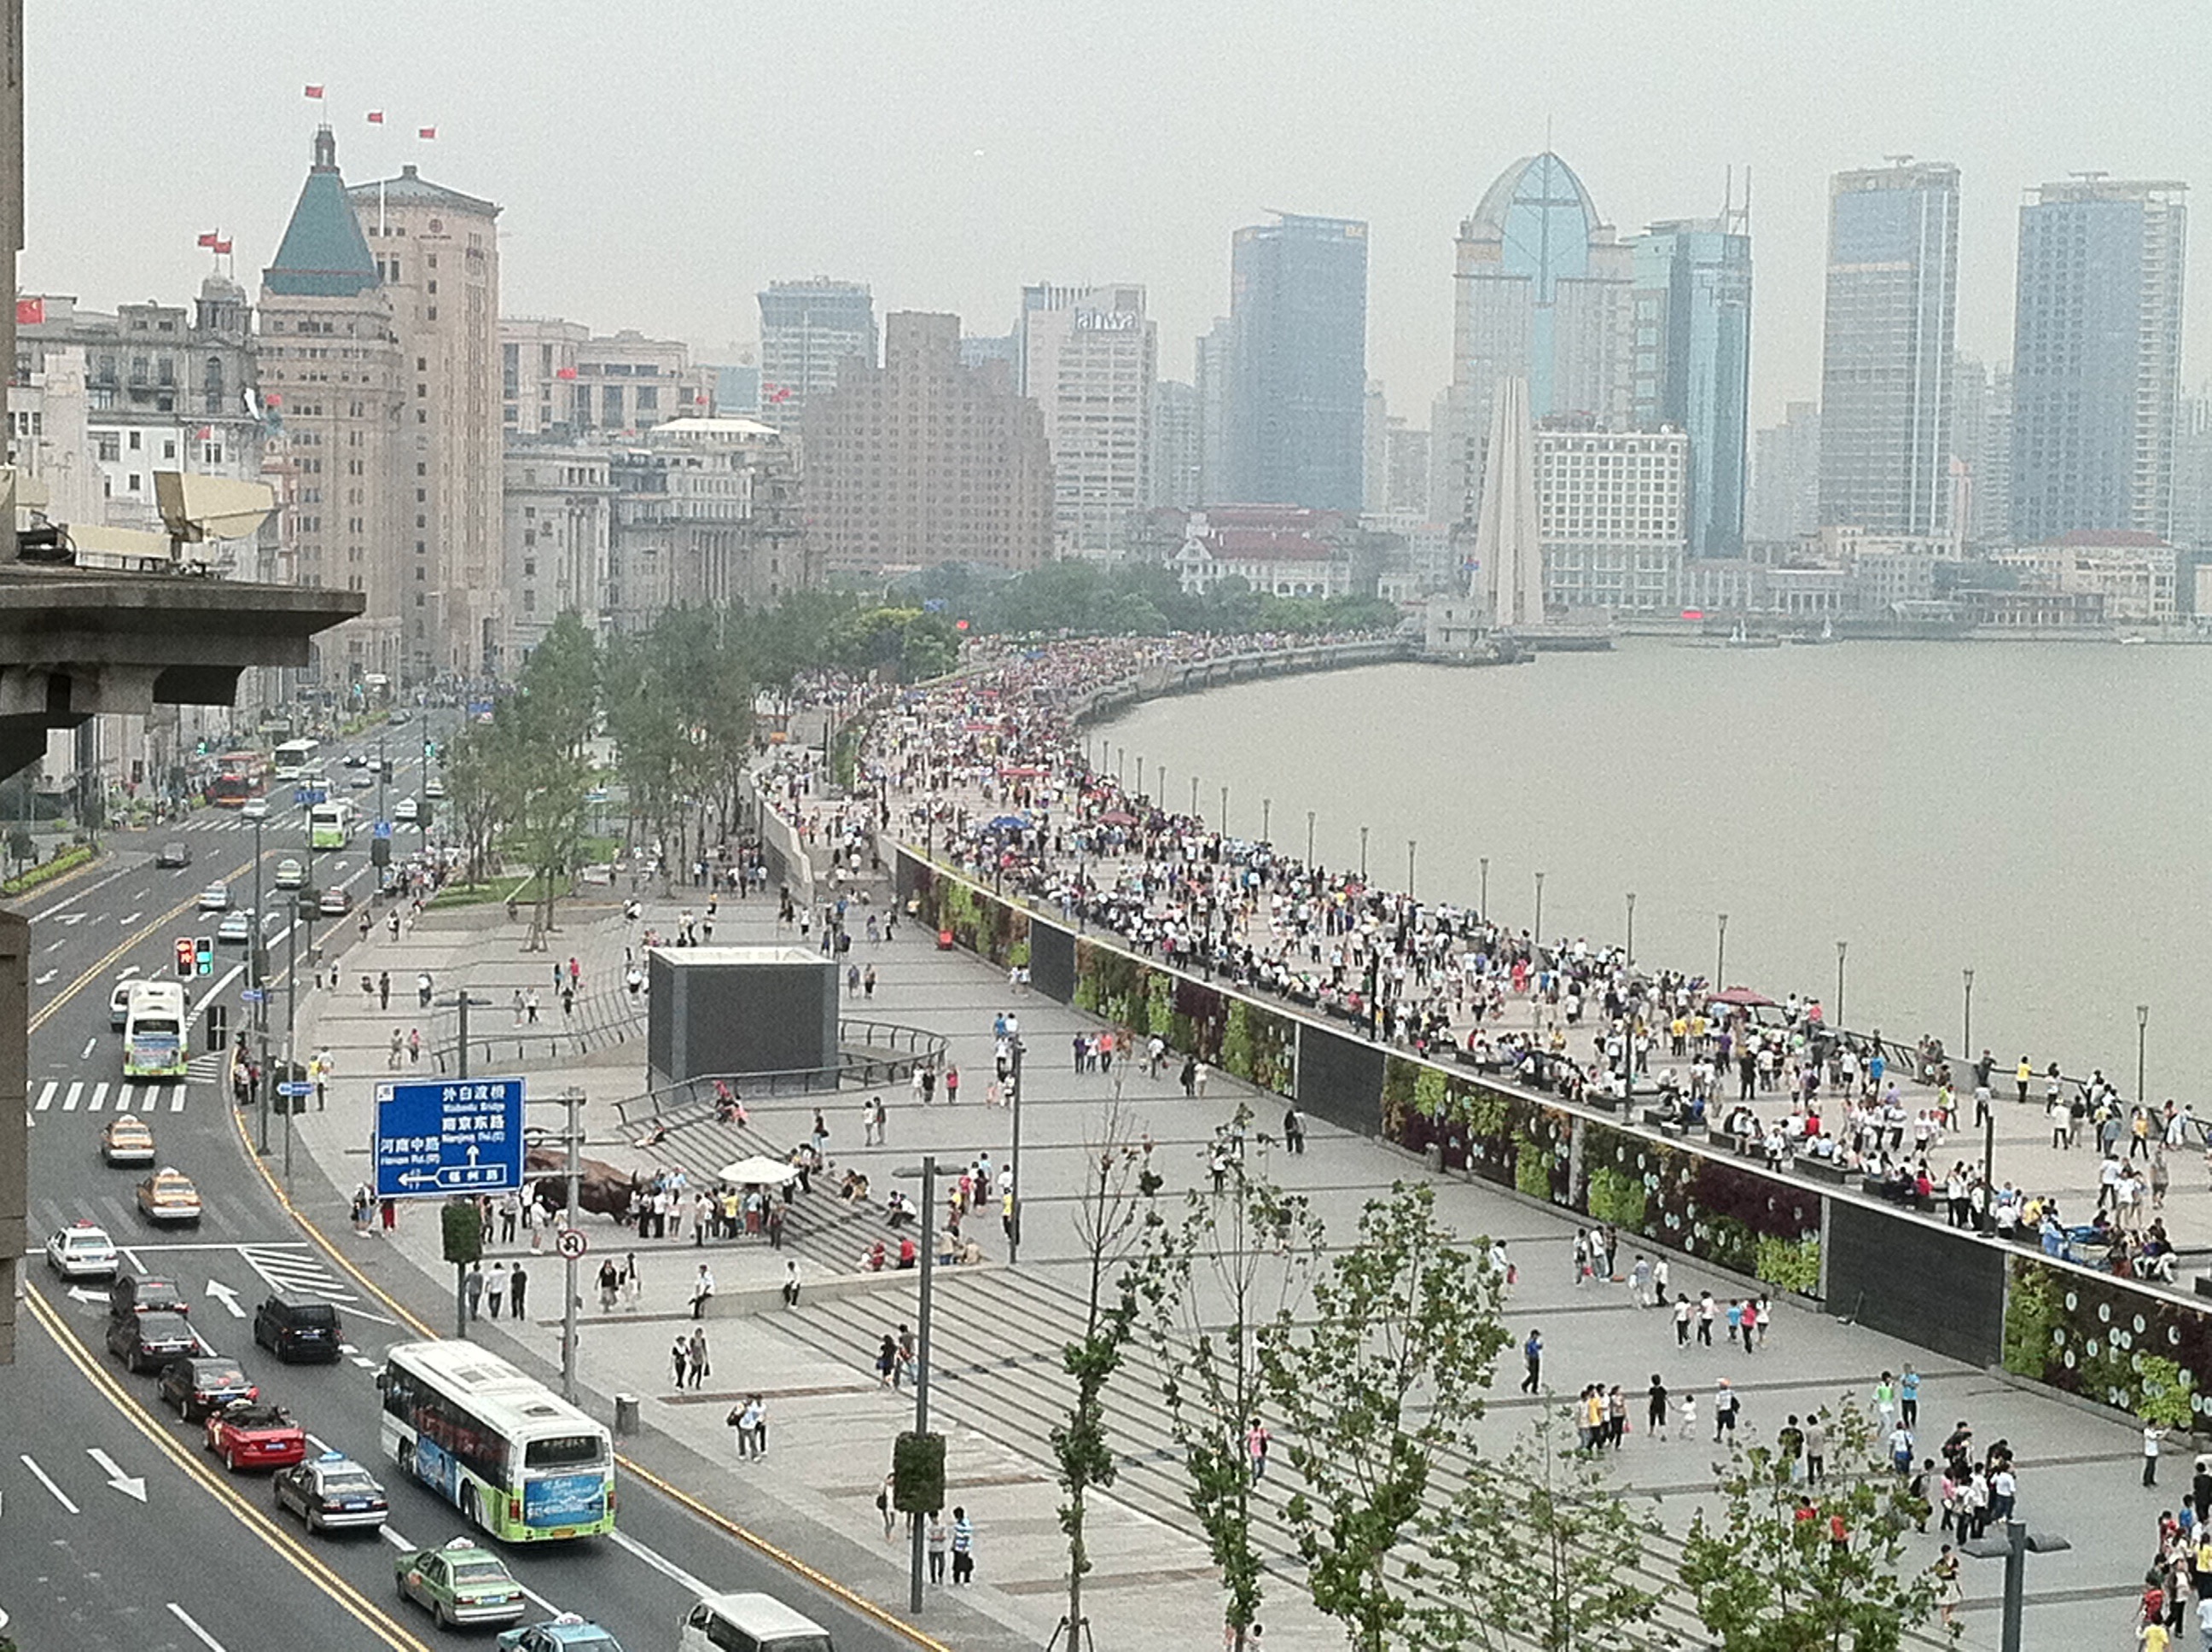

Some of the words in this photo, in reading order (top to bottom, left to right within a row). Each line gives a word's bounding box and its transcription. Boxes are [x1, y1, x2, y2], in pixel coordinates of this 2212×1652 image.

[442, 1114, 504, 1131] 南京东路
[381, 1137, 439, 1154] 河南中路
